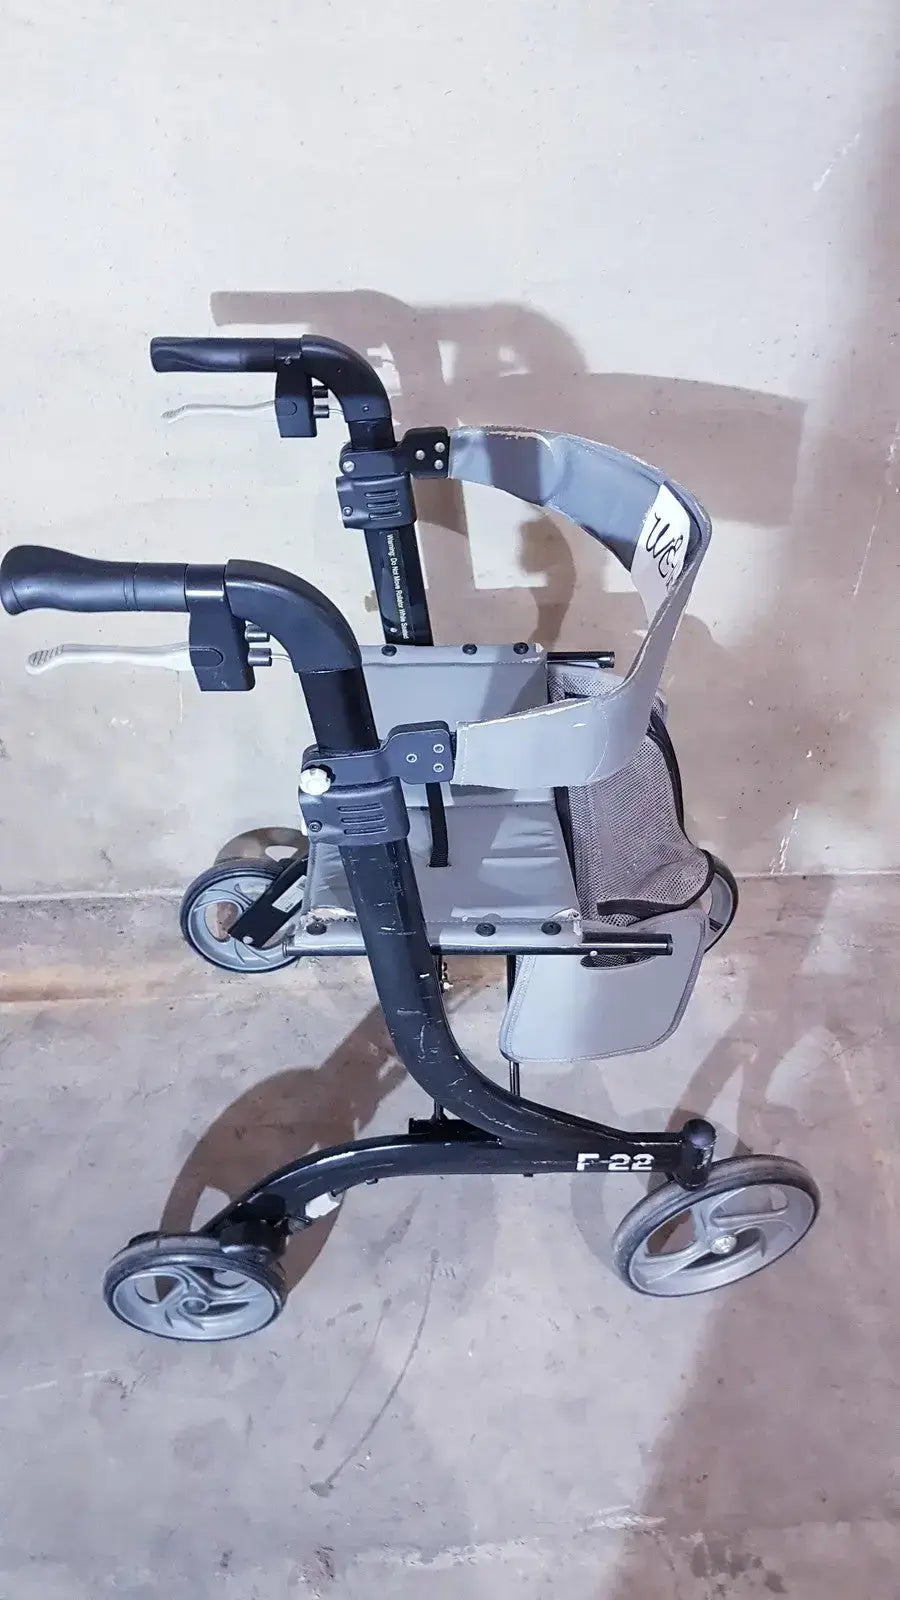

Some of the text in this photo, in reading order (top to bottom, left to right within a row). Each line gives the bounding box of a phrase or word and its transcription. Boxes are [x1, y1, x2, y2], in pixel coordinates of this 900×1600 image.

[390, 558, 397, 566] Do
[393, 576, 401, 589] Move
[401, 623, 409, 639] Seated
